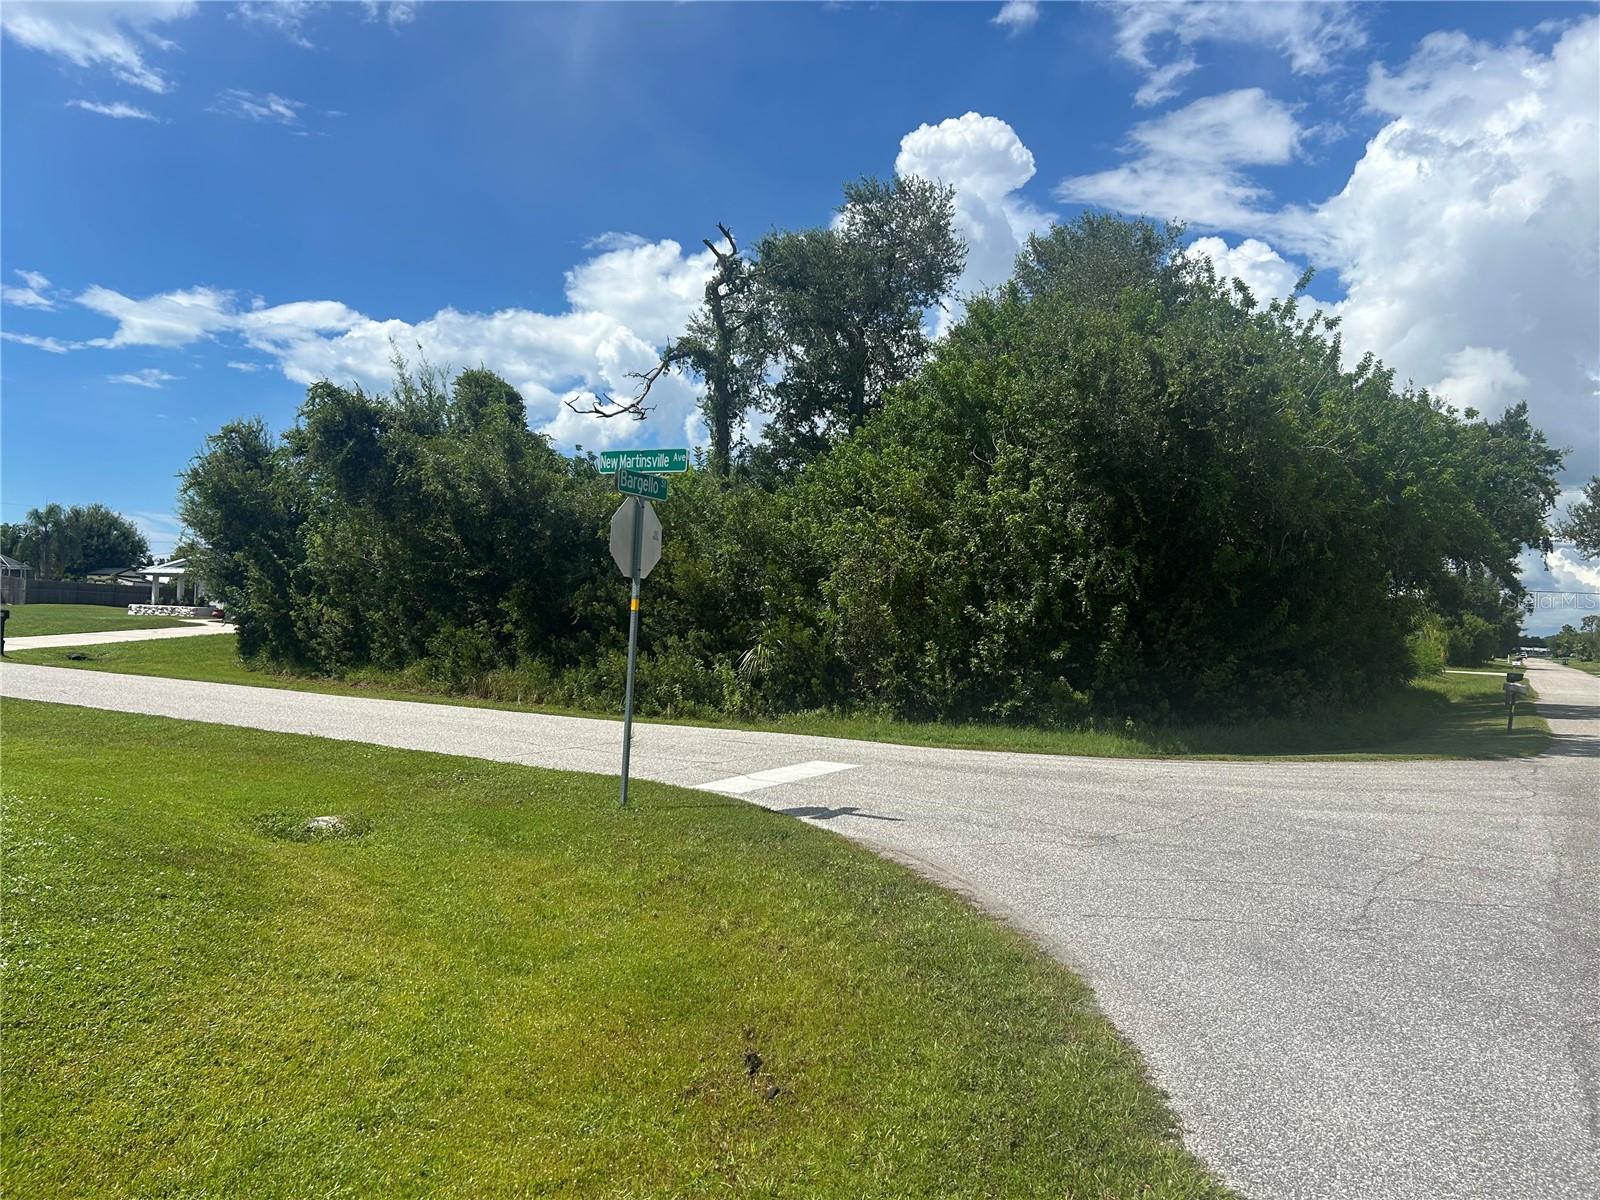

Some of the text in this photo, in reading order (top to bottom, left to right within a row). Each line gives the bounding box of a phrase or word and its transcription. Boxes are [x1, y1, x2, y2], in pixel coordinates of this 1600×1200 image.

[600, 453, 686, 469] New Martinsville Ave
[620, 470, 659, 494] Bargello
